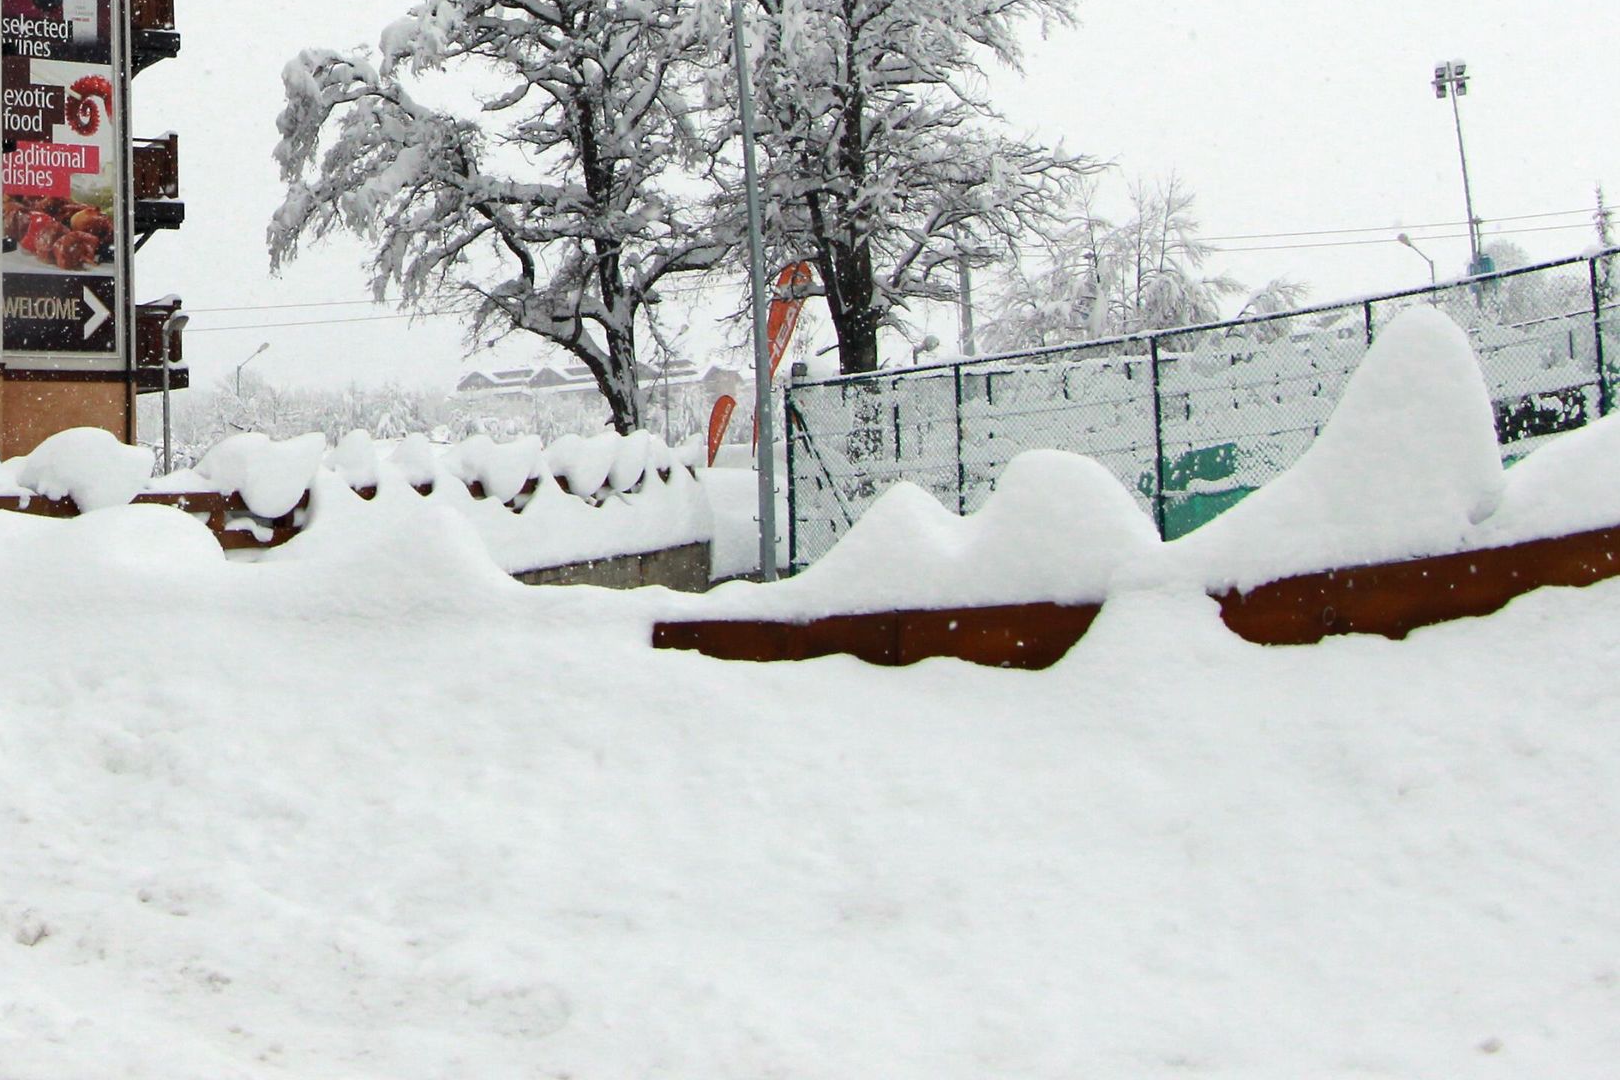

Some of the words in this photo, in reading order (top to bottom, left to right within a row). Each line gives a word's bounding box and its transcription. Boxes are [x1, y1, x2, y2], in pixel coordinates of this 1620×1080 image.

[2, 13, 69, 39] selected
[2, 37, 51, 57] ines
[4, 87, 54, 109] exotic
[4, 107, 43, 132] food
[2, 164, 53, 187] dishes
[3, 296, 81, 321] WELCOME
